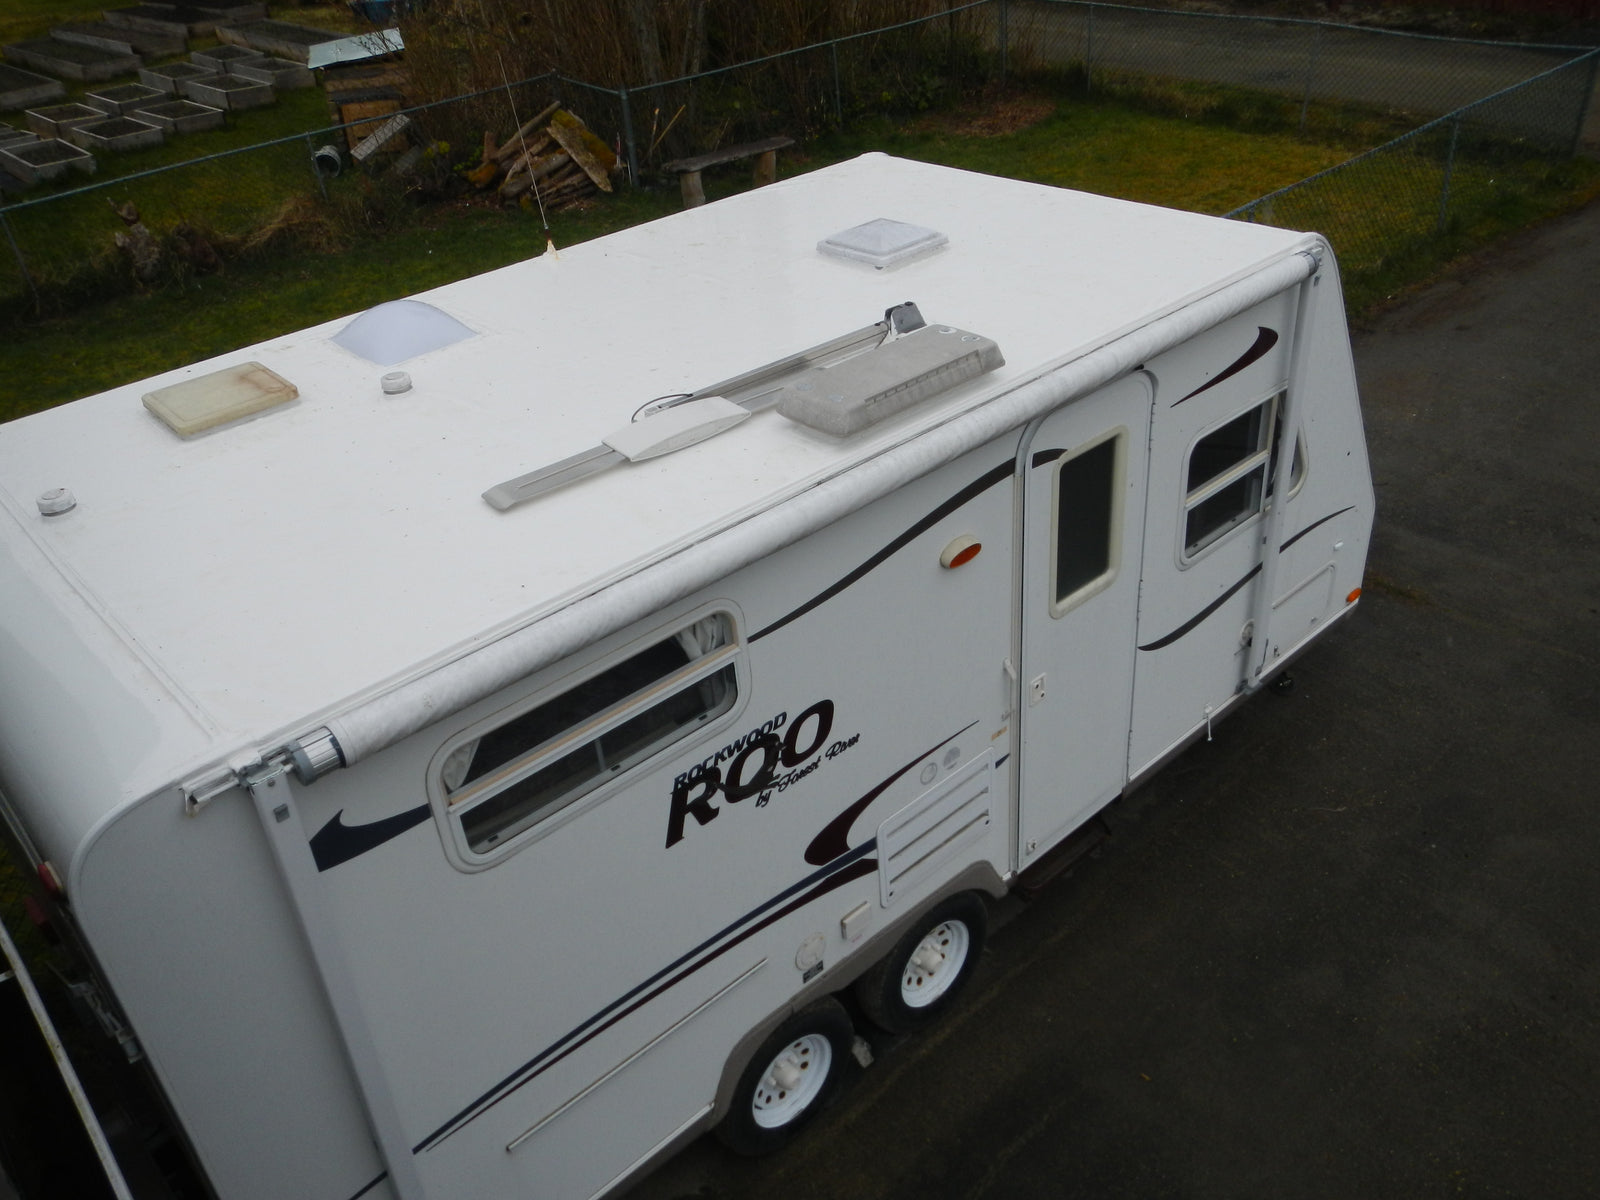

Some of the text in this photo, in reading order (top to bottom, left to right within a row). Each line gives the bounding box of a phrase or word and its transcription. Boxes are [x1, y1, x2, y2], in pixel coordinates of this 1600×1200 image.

[665, 699, 834, 849] ROO
[674, 711, 787, 788] ROCKWOOD
[755, 733, 860, 808] by Forest River
